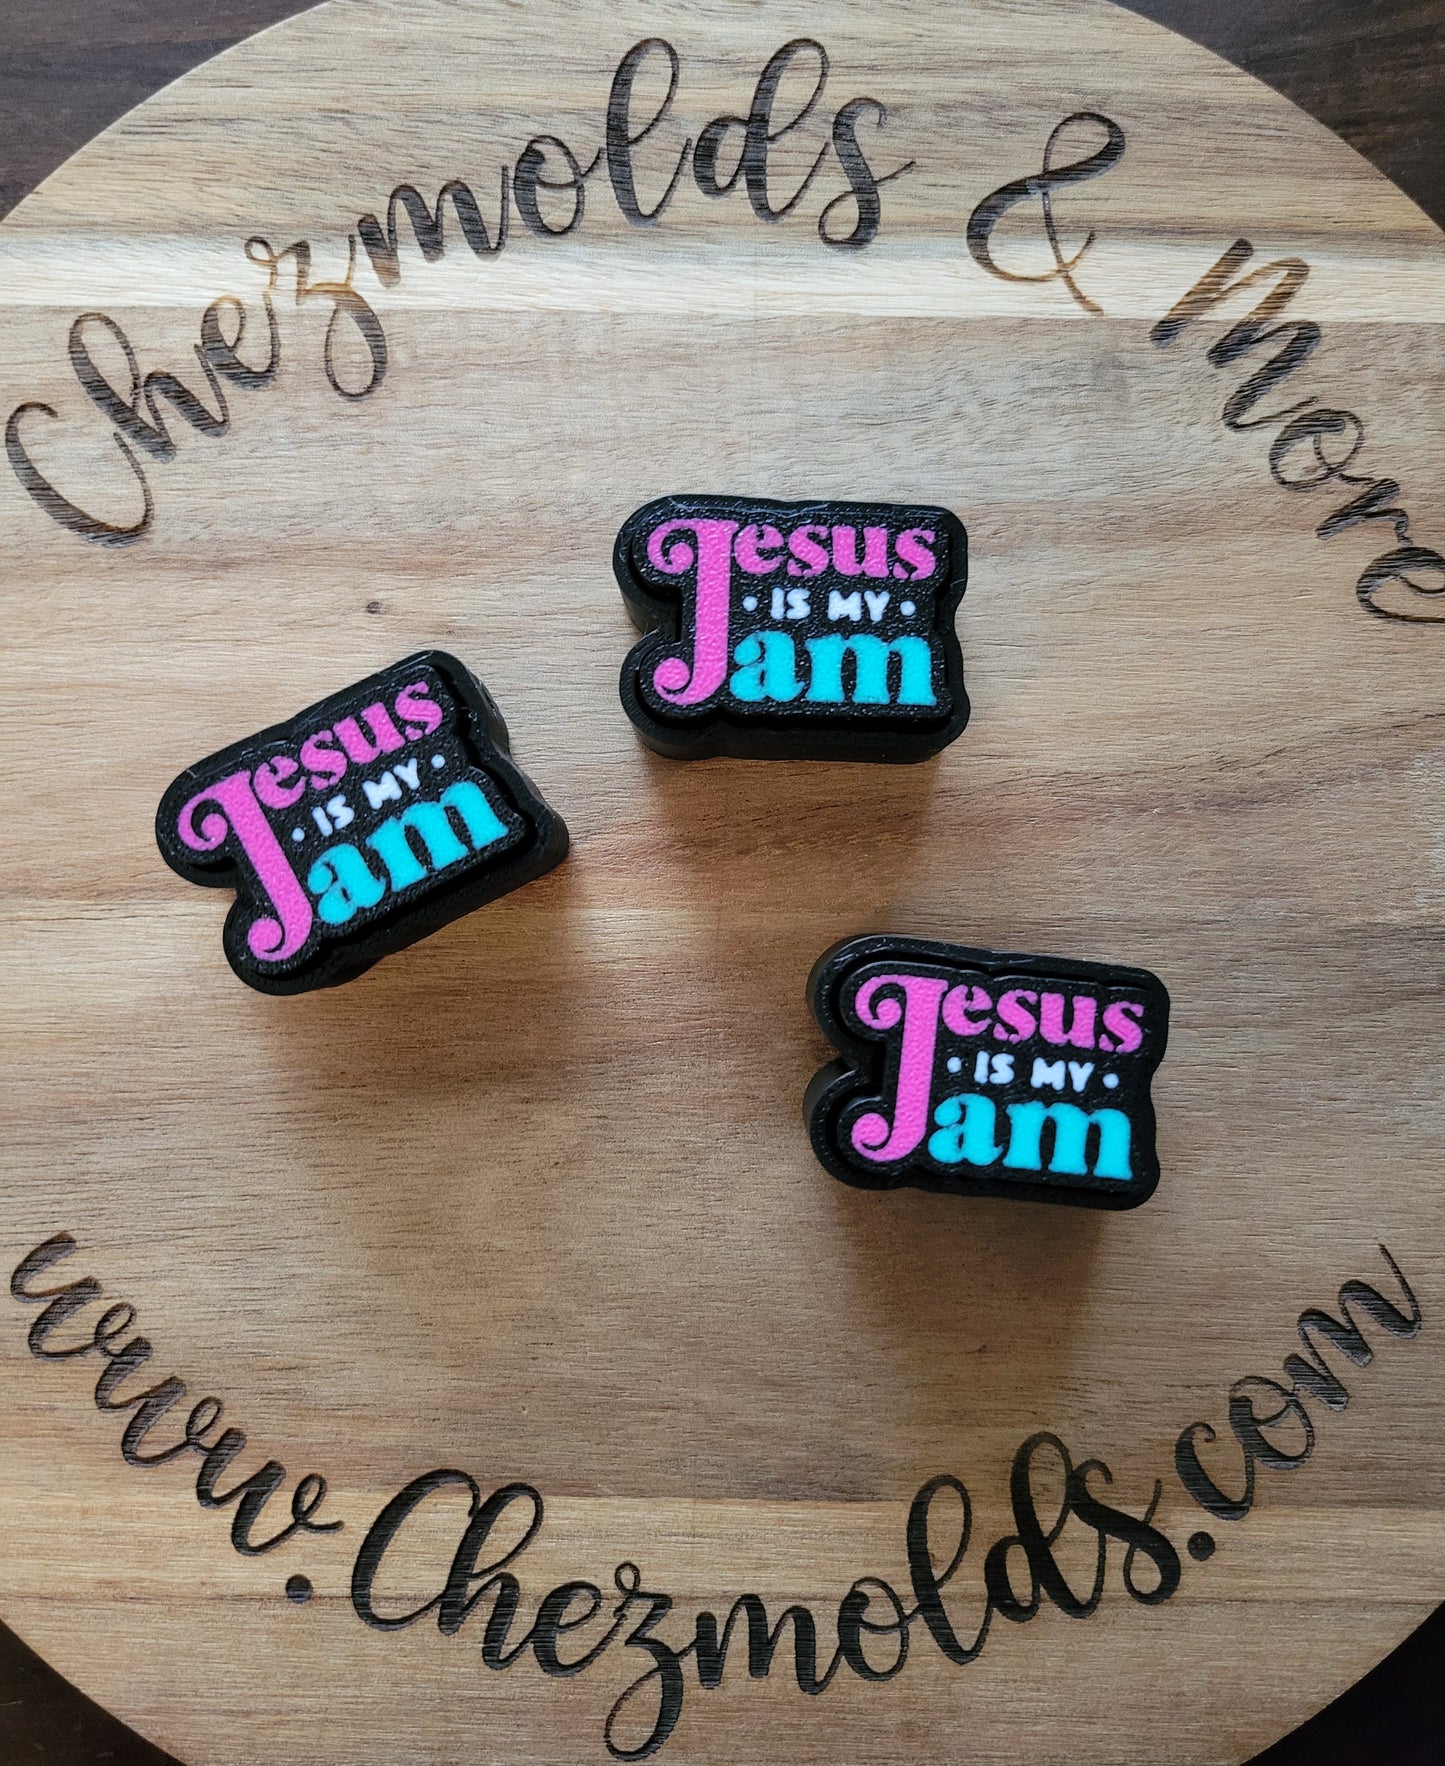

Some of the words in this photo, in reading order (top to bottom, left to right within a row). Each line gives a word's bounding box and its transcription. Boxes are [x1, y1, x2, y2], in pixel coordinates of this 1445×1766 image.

[5, 37, 916, 547] Chezmolds
[967, 111, 1126, 317] &
[647, 520, 935, 704] Jesus
[771, 590, 810, 619] IS
[828, 593, 889, 621] MY
[178, 683, 442, 960] Jesus
[316, 796, 354, 835] IS
[366, 759, 420, 809] MY
[851, 975, 1142, 1161] Jesus
[976, 1054, 1009, 1080] IS
[1031, 1062, 1090, 1089] MY
